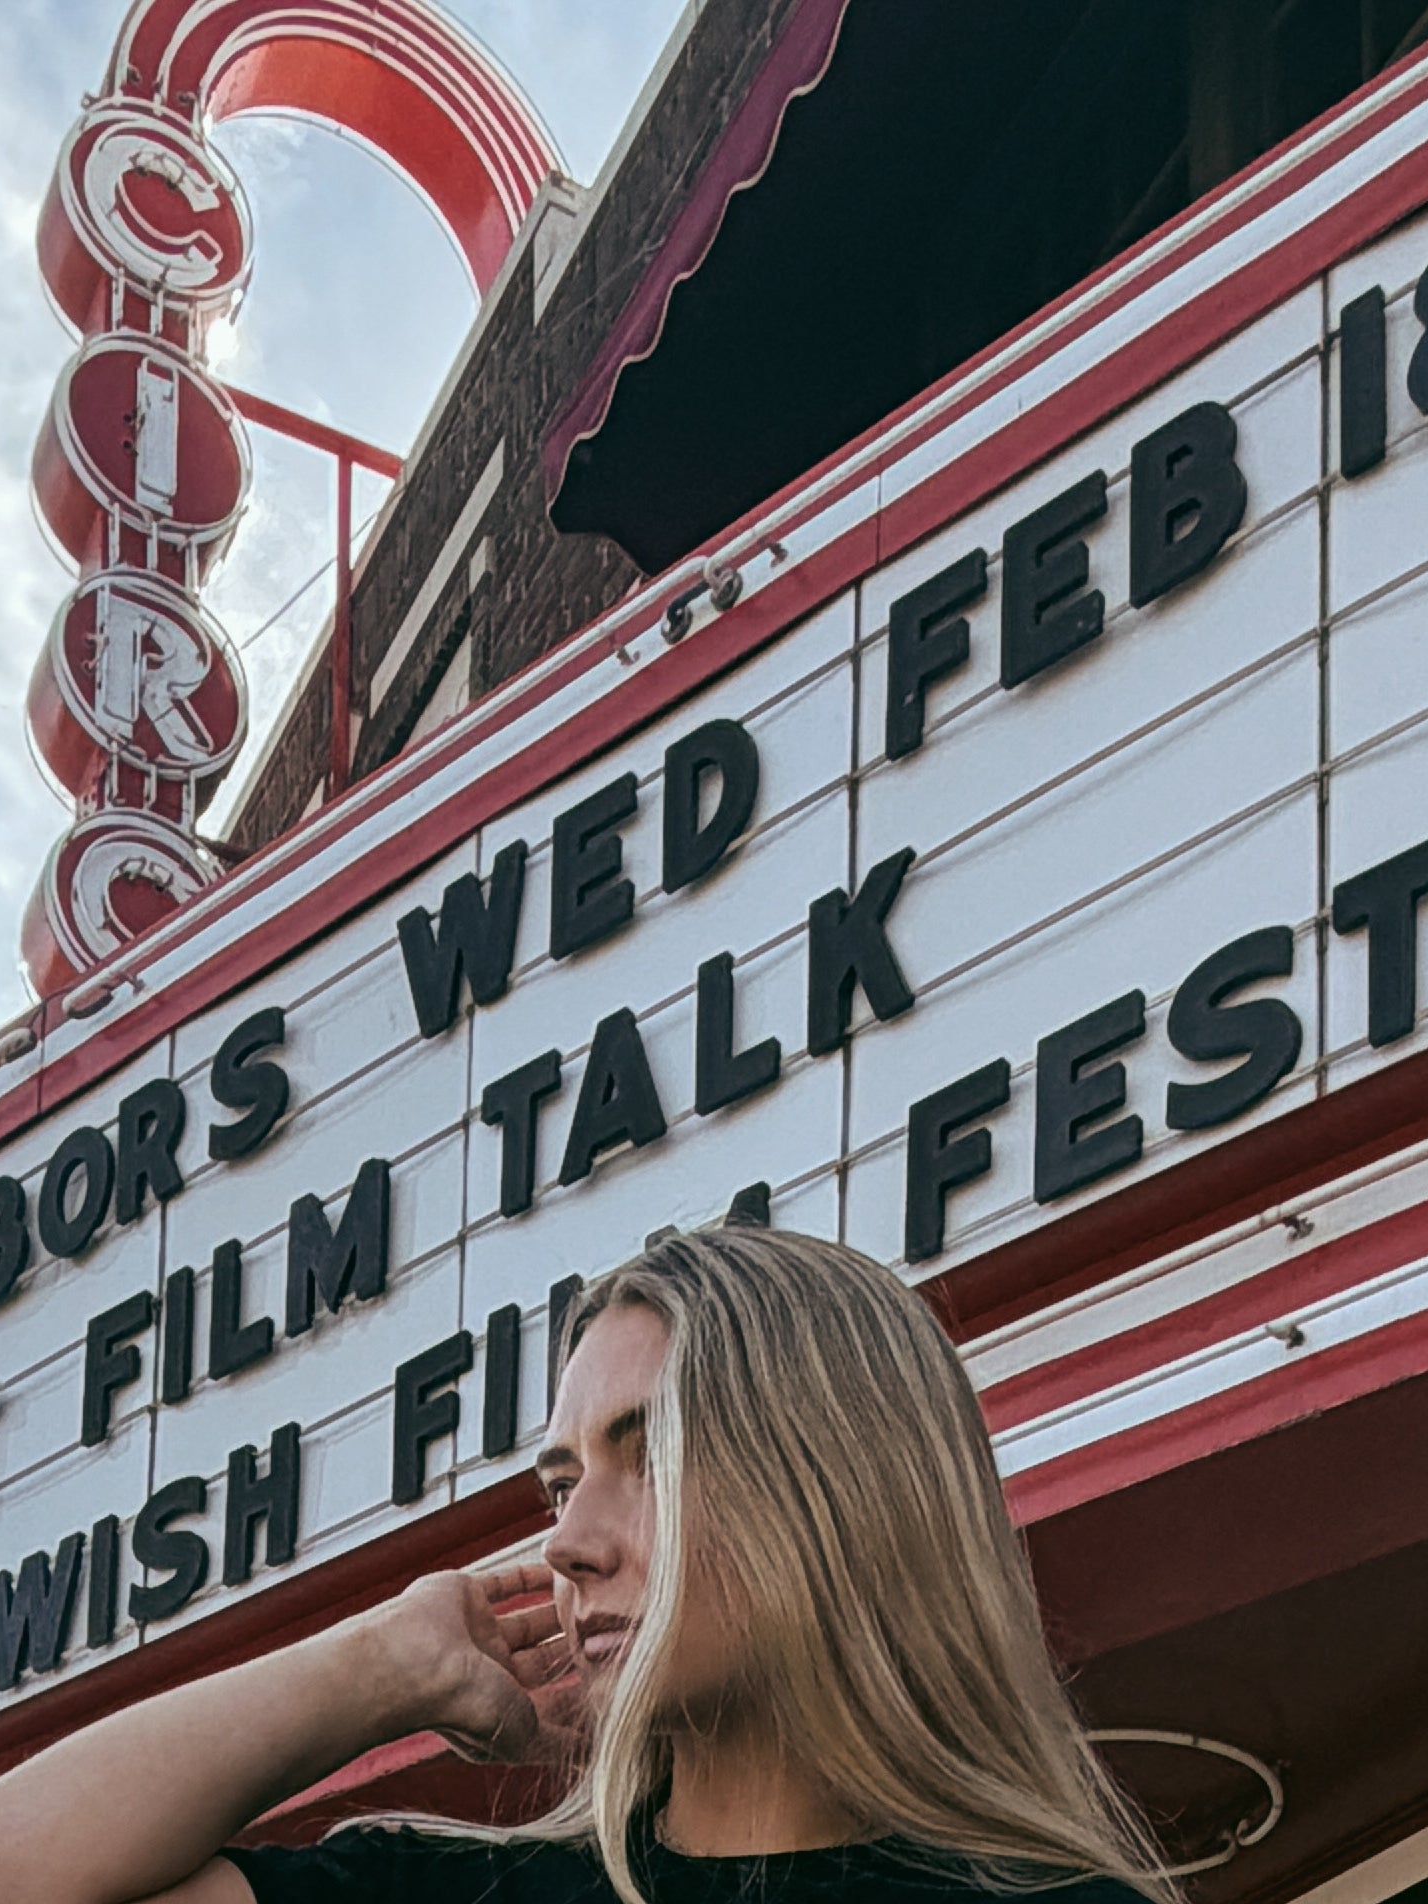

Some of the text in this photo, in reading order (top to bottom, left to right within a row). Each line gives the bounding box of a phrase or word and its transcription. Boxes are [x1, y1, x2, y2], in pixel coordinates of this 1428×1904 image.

[396, 718, 761, 1040] WED
[885, 401, 1247, 761] FEB
[81, 1158, 392, 1447] FILM
[481, 846, 917, 1218] TALK
